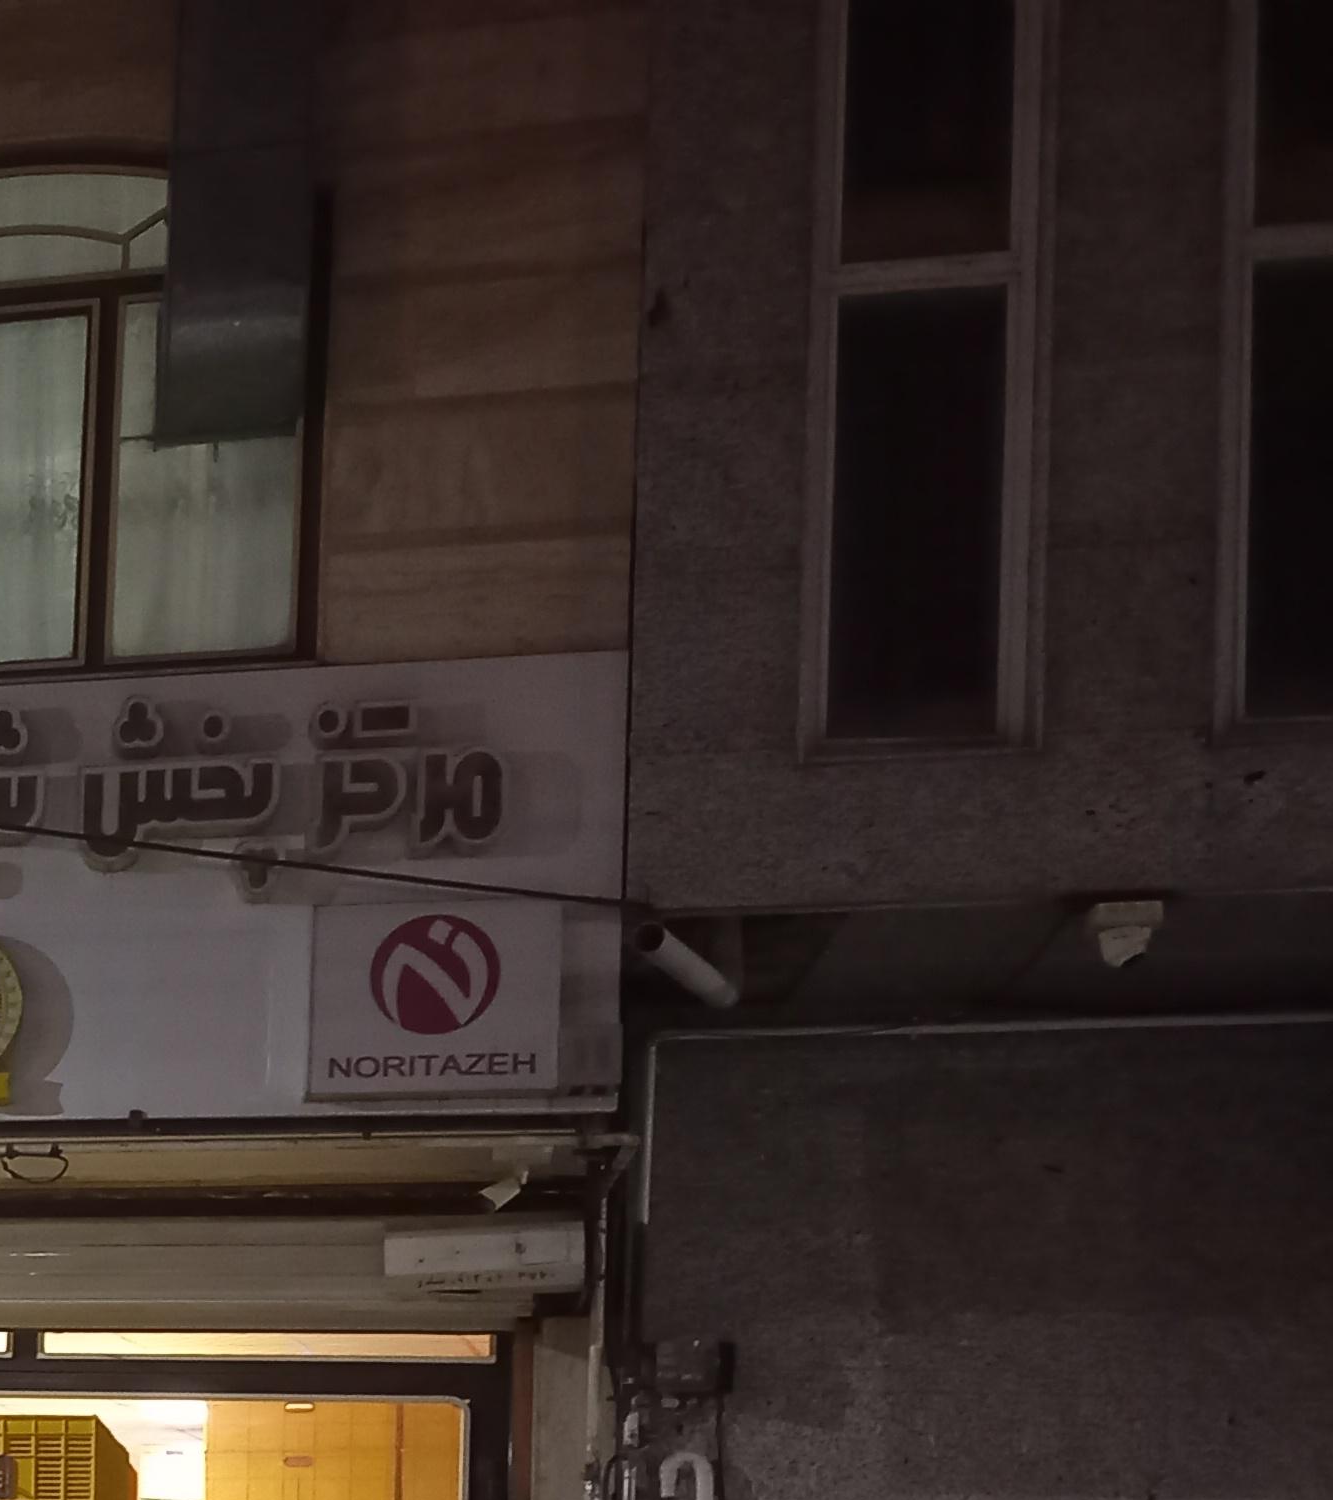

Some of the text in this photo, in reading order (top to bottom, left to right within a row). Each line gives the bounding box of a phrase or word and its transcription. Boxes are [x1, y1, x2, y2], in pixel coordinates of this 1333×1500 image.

[80, 696, 278, 903] پخش
[310, 699, 505, 851] مرکز
[328, 1054, 536, 1078] NORITAZEH
